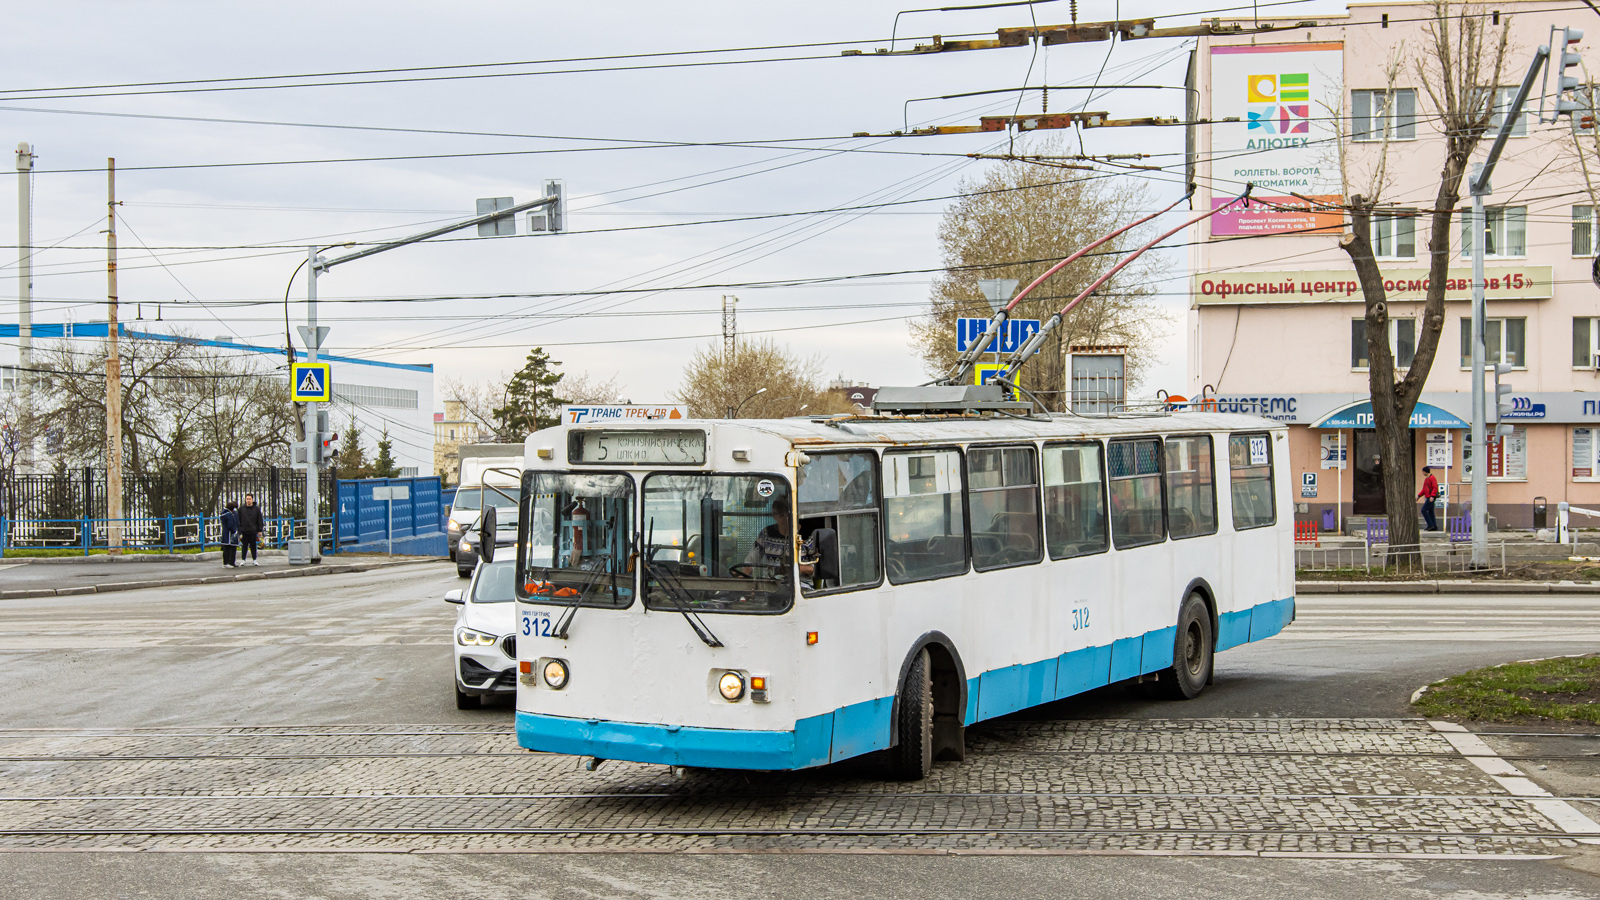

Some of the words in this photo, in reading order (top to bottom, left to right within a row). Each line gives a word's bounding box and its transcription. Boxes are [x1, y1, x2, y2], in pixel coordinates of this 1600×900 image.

[1246, 137, 1309, 150] АЛЮТЕХ
[1234, 168, 1280, 177] РОЛЛЕТЫ.
[1283, 167, 1320, 176] ВОРОТА
[1201, 278, 1295, 299] Офисный
[1301, 280, 1358, 296] центр
[591, 408, 622, 418] ТРАНС
[1583, 400, 1600, 415] П
[597, 437, 608, 460] 5
[618, 437, 704, 448] КОММУНИСТИЧЕСКА
[1251, 440, 1264, 456] 312
[522, 616, 551, 637] 312
[1071, 606, 1090, 631] 312
